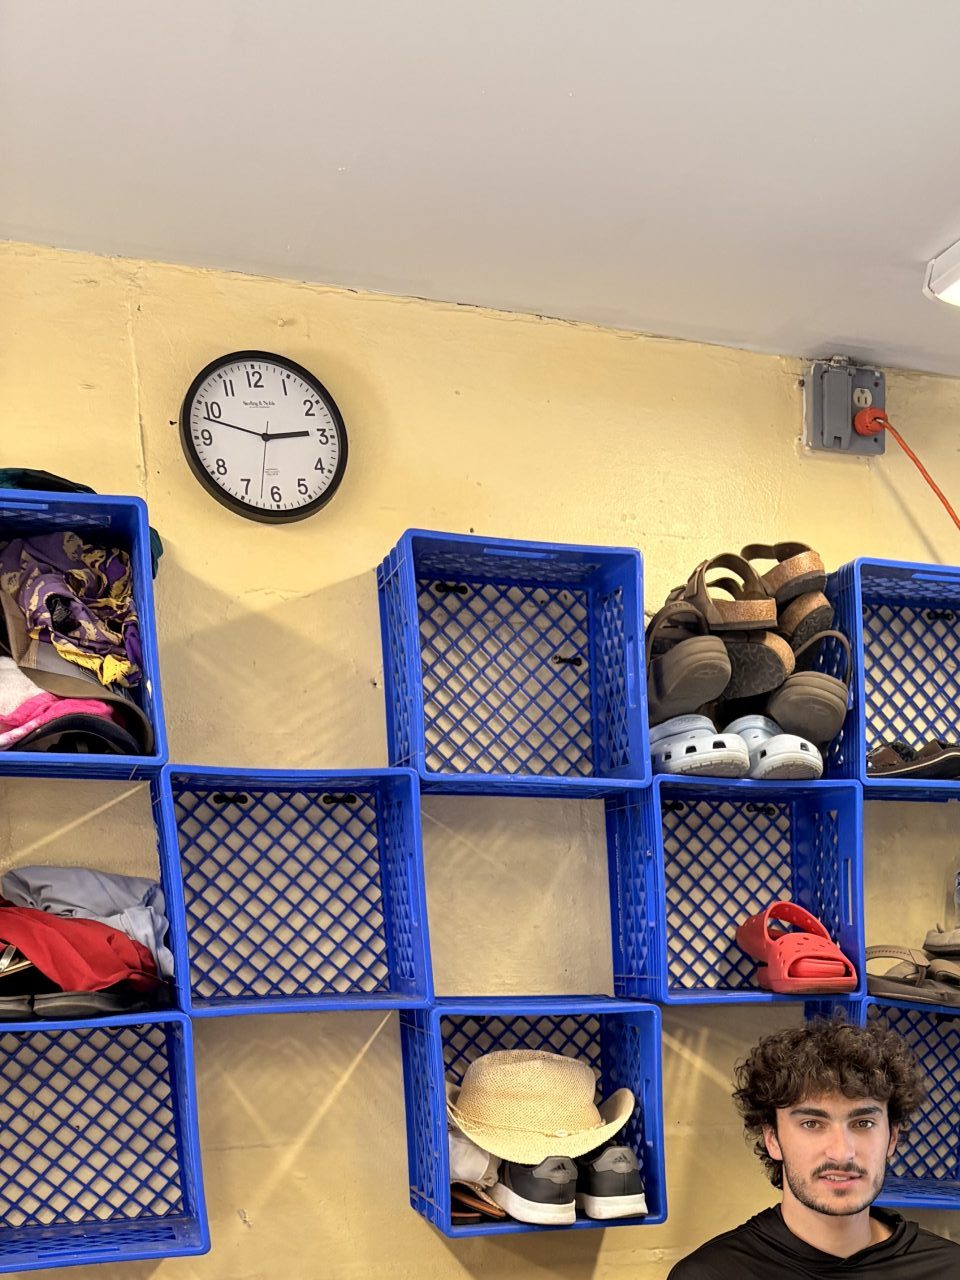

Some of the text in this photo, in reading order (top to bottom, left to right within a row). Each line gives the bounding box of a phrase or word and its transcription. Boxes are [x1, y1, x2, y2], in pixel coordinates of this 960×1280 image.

[223, 379, 235, 397] 11
[246, 370, 265, 388] 12
[281, 378, 288, 396] 1
[205, 401, 222, 420] 10
[303, 399, 316, 417] 2
[200, 429, 213, 447] 9
[316, 428, 329, 445] 3
[215, 458, 228, 476] 8
[314, 457, 326, 475] 4
[240, 478, 251, 496] 7
[270, 485, 282, 503] 6
[297, 478, 309, 495] 5
